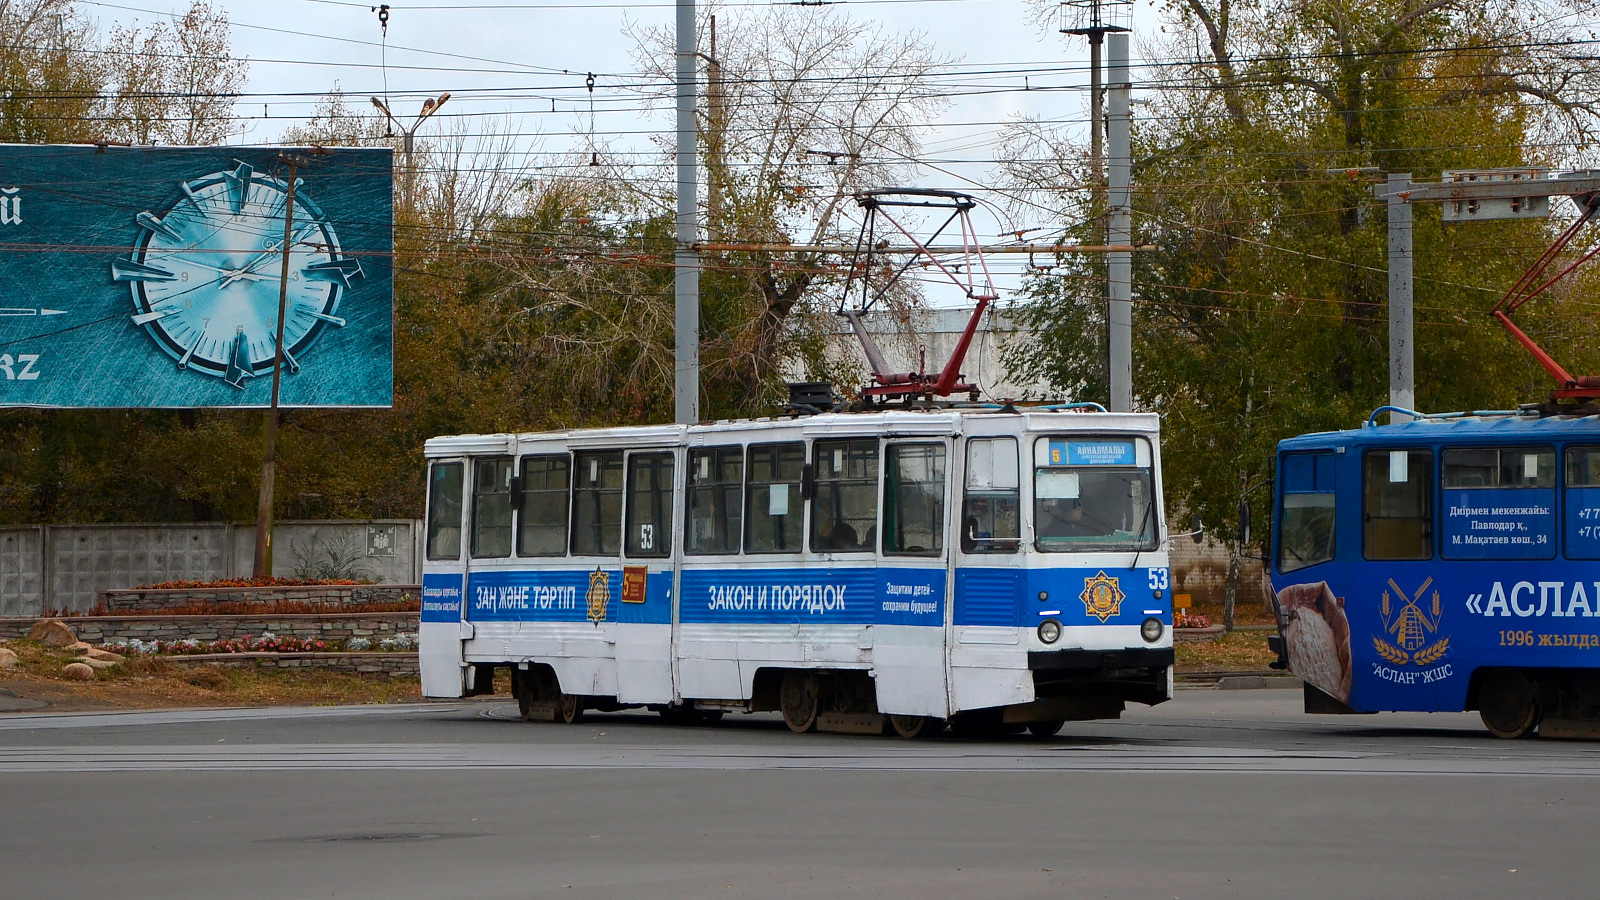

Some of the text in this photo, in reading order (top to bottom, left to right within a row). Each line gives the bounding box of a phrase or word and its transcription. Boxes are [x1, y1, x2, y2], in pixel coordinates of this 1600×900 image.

[181, 272, 189, 283] 9
[292, 271, 300, 282] 3
[185, 299, 193, 309] 8
[203, 318, 211, 328] 7
[236, 325, 244, 336] 6
[1052, 449, 1061, 463] 5
[1077, 444, 1125, 455] АЙНАЛМАЛЫ
[1449, 505, 1550, 517] Диірмен мекенжайы:
[1578, 508, 1591, 519] +7
[1471, 521, 1515, 531] Павлодар
[1578, 526, 1591, 538] +7
[641, 524, 653, 549] 53
[1452, 534, 1548, 545] М. Мақатаев көш., 34
[623, 572, 629, 596] 5
[1148, 567, 1168, 590] 53
[886, 581, 912, 596] Защитим
[913, 583, 931, 597] детей
[475, 586, 576, 614] ЗАҢ ЖӘНЕ ТӘРТІП
[708, 584, 847, 615] ЗАКОН И ПОРЯДОК
[1465, 580, 1600, 617] «АСЛА
[882, 599, 938, 615] сохраним будущее!
[1499, 630, 1535, 647] 1996
[1421, 664, 1453, 683] ЖШС
